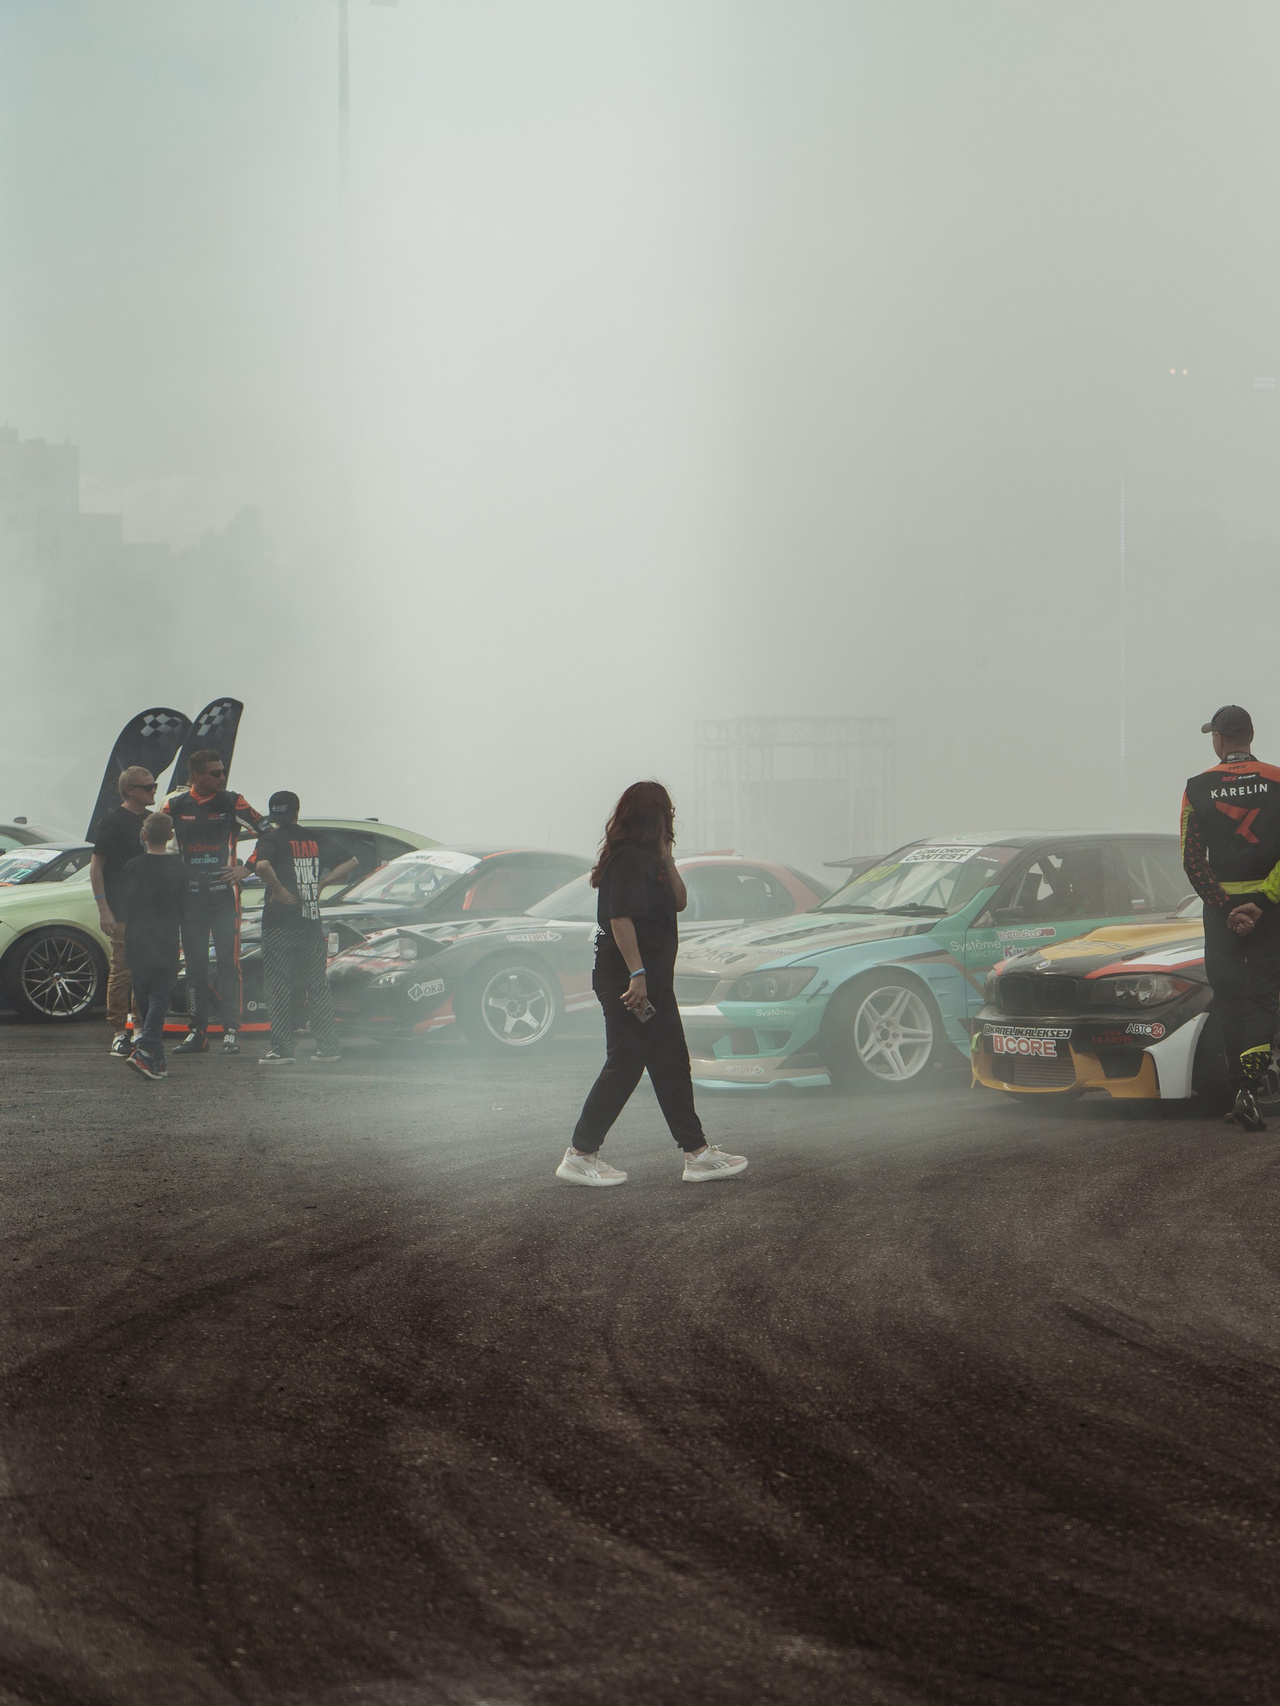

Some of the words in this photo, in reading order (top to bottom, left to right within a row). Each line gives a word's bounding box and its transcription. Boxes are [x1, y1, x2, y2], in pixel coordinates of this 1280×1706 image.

[1210, 783, 1268, 799] KARELIN
[289, 840, 319, 857] TEAM
[938, 847, 975, 855] DRIFT
[905, 853, 967, 861] CONTEST
[508, 933, 548, 942] DRYDRY
[984, 1024, 1072, 1039] @KARELIN.ALEKSEY
